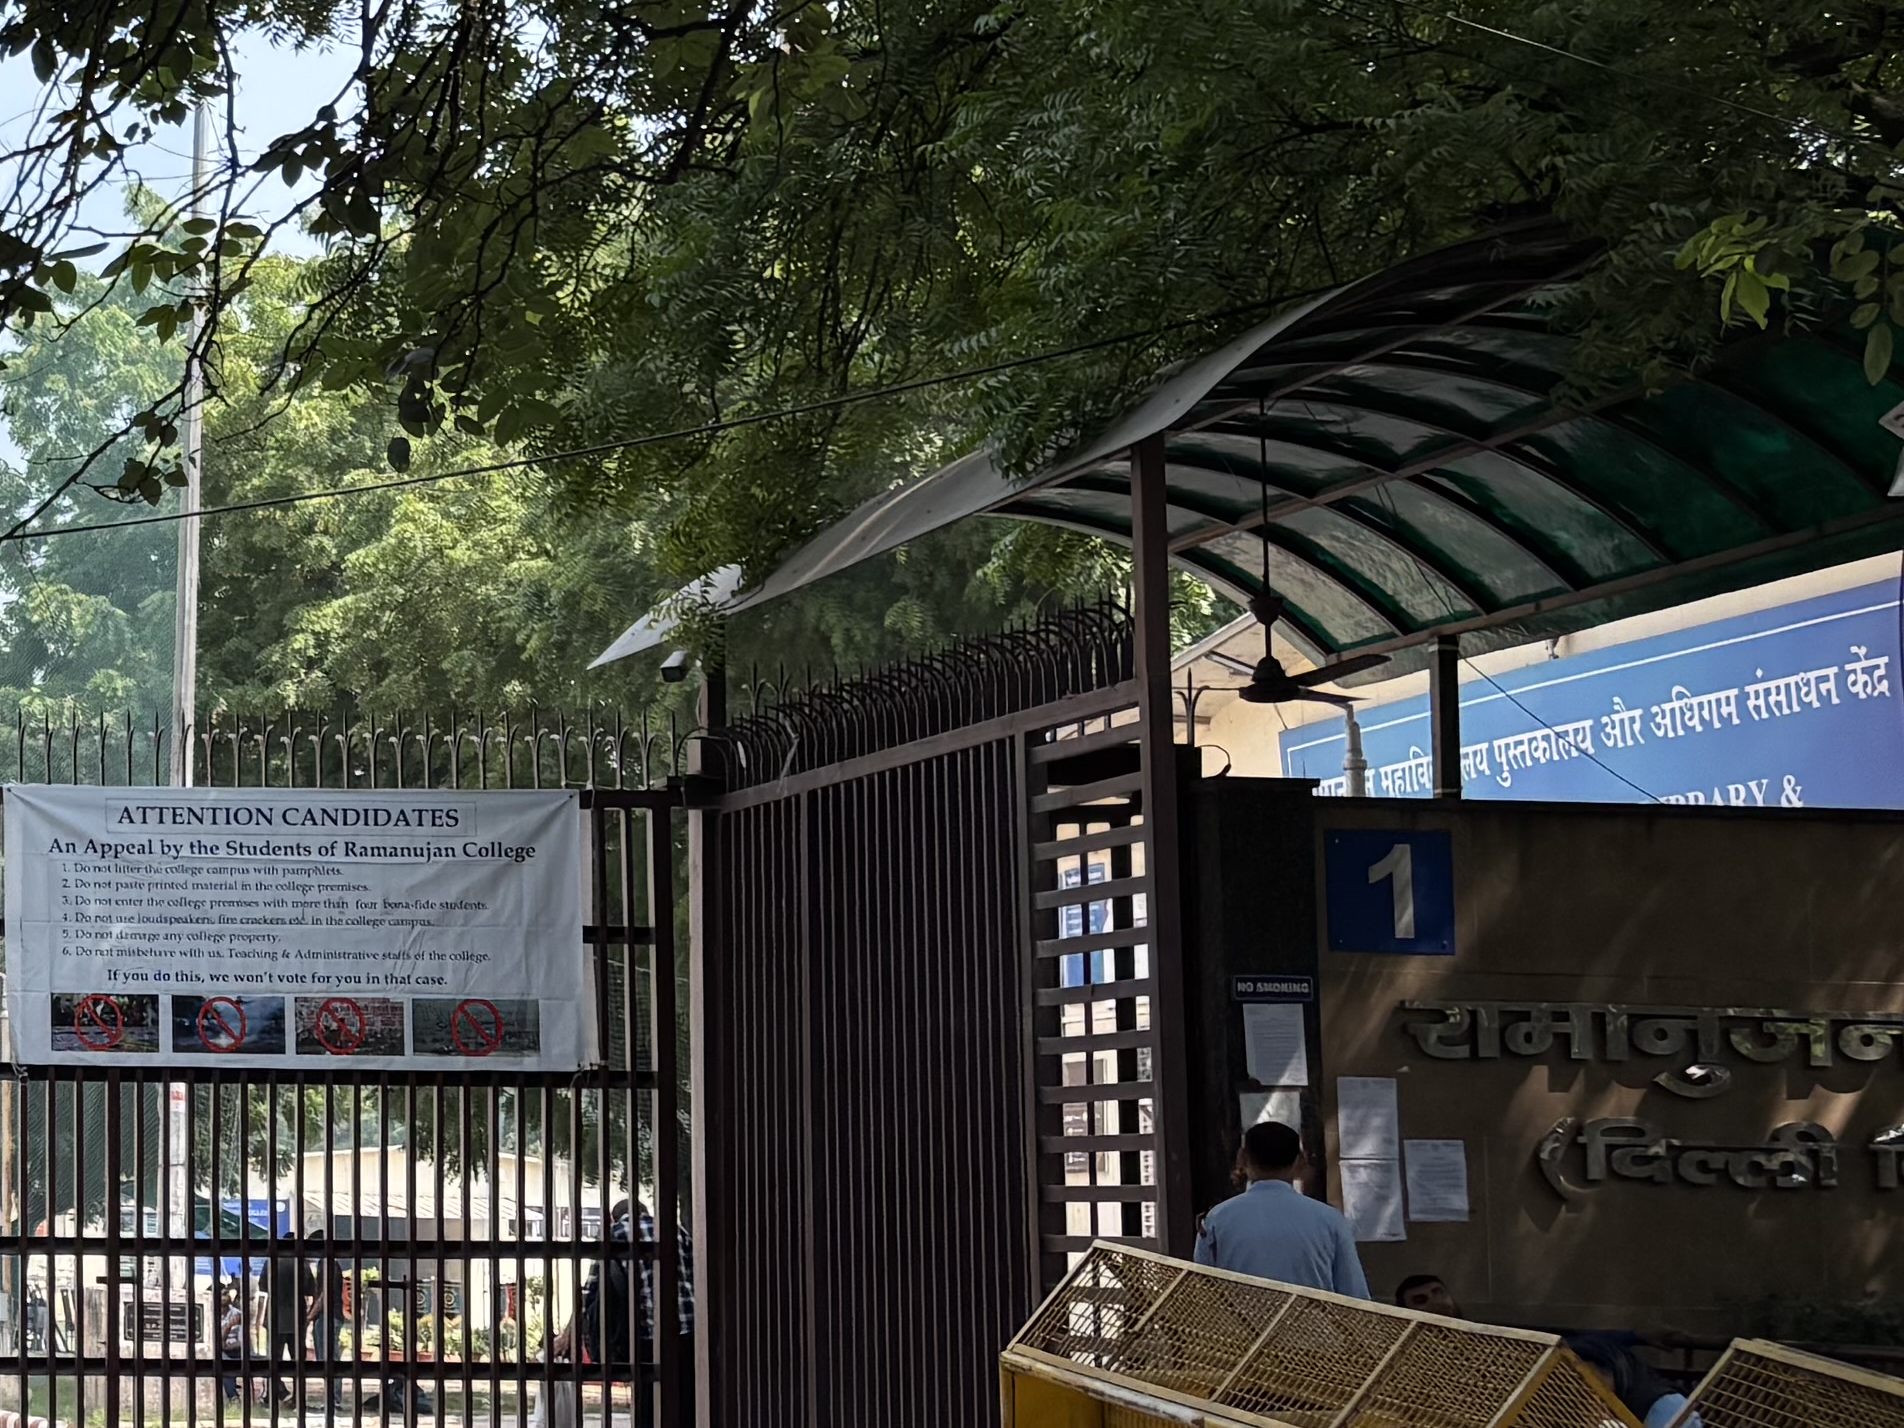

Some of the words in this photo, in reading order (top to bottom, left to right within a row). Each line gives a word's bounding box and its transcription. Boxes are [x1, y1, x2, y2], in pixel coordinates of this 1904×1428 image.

[1494, 719, 1596, 788] पुस्तकालय
[1600, 696, 1645, 748] और
[1650, 684, 1741, 738] अधिगम
[1744, 668, 1841, 721] संसाधन
[1780, 774, 1803, 808] &
[118, 806, 274, 826] ATTENTION
[282, 807, 459, 827] CANDIDATES
[48, 838, 77, 854] An
[84, 838, 154, 859] Appeal
[160, 839, 184, 859] by
[190, 840, 220, 855] the
[226, 840, 312, 857] Students
[318, 841, 338, 857] of
[344, 841, 457, 862] Ramanujan
[462, 842, 536, 862] College
[74, 862, 90, 873] Do
[95, 863, 112, 873] not
[145, 863, 162, 874] the
[165, 863, 204, 877] college
[206, 865, 250, 877] campus
[253, 864, 279, 875] with
[75, 878, 90, 889] Do
[95, 879, 112, 889] not
[115, 880, 145, 892] paste
[148, 880, 188, 893] printed
[192, 880, 238, 891] material
[241, 881, 252, 891] in
[255, 881, 273, 892] the
[275, 882, 315, 896] college
[1368, 844, 1415, 939] 1
[75, 895, 91, 906] Do
[95, 896, 112, 906] not
[115, 897, 143, 906] enter
[146, 897, 165, 907] the
[167, 897, 207, 911] college
[210, 898, 259, 911] premises
[263, 897, 288, 908] with
[292, 899, 322, 909] more
[323, 898, 349, 909] than
[355, 899, 378, 910] four
[75, 913, 91, 923] Do
[95, 914, 112, 923] not
[116, 915, 135, 924] use
[218, 914, 237, 925] fire
[311, 916, 322, 925] in
[325, 916, 343, 926] the
[345, 916, 385, 930] college
[75, 930, 91, 939] Do
[95, 930, 112, 940] not
[163, 933, 183, 944] any
[186, 932, 226, 944] college
[75, 946, 92, 956] Do
[179, 948, 204, 958] with
[228, 948, 278, 961] Teaching
[295, 949, 380, 961] Administrative
[414, 950, 426, 961] of
[428, 950, 446, 961] the
[448, 951, 491, 964] college.
[107, 969, 120, 981] If
[122, 972, 149, 985] you
[153, 970, 171, 982] do
[175, 970, 205, 984] this,
[209, 973, 230, 983] we
[277, 974, 307, 984] vote
[311, 972, 332, 984] for
[336, 974, 362, 987] you
[366, 973, 380, 984] in
[383, 973, 411, 985] that
[415, 975, 448, 985] case.
[1237, 982, 1254, 992] NO
